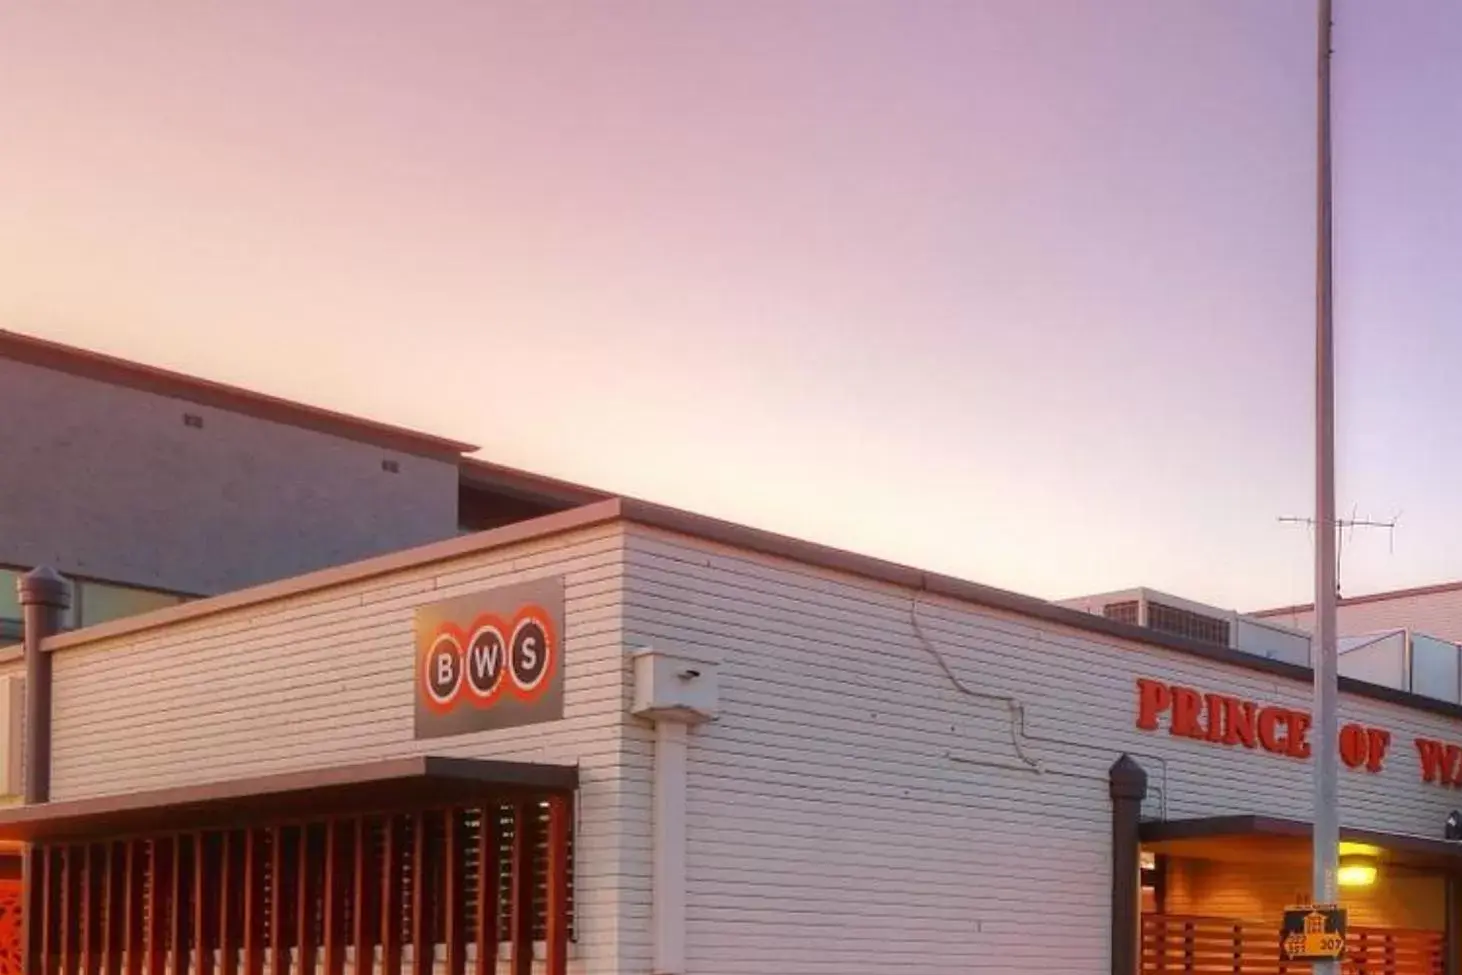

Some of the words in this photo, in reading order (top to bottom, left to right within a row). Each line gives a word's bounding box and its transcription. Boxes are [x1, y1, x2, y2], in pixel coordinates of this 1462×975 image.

[437, 637, 538, 685] BWS
[1136, 678, 1312, 758] PRINCE
[1339, 722, 1390, 772] OF
